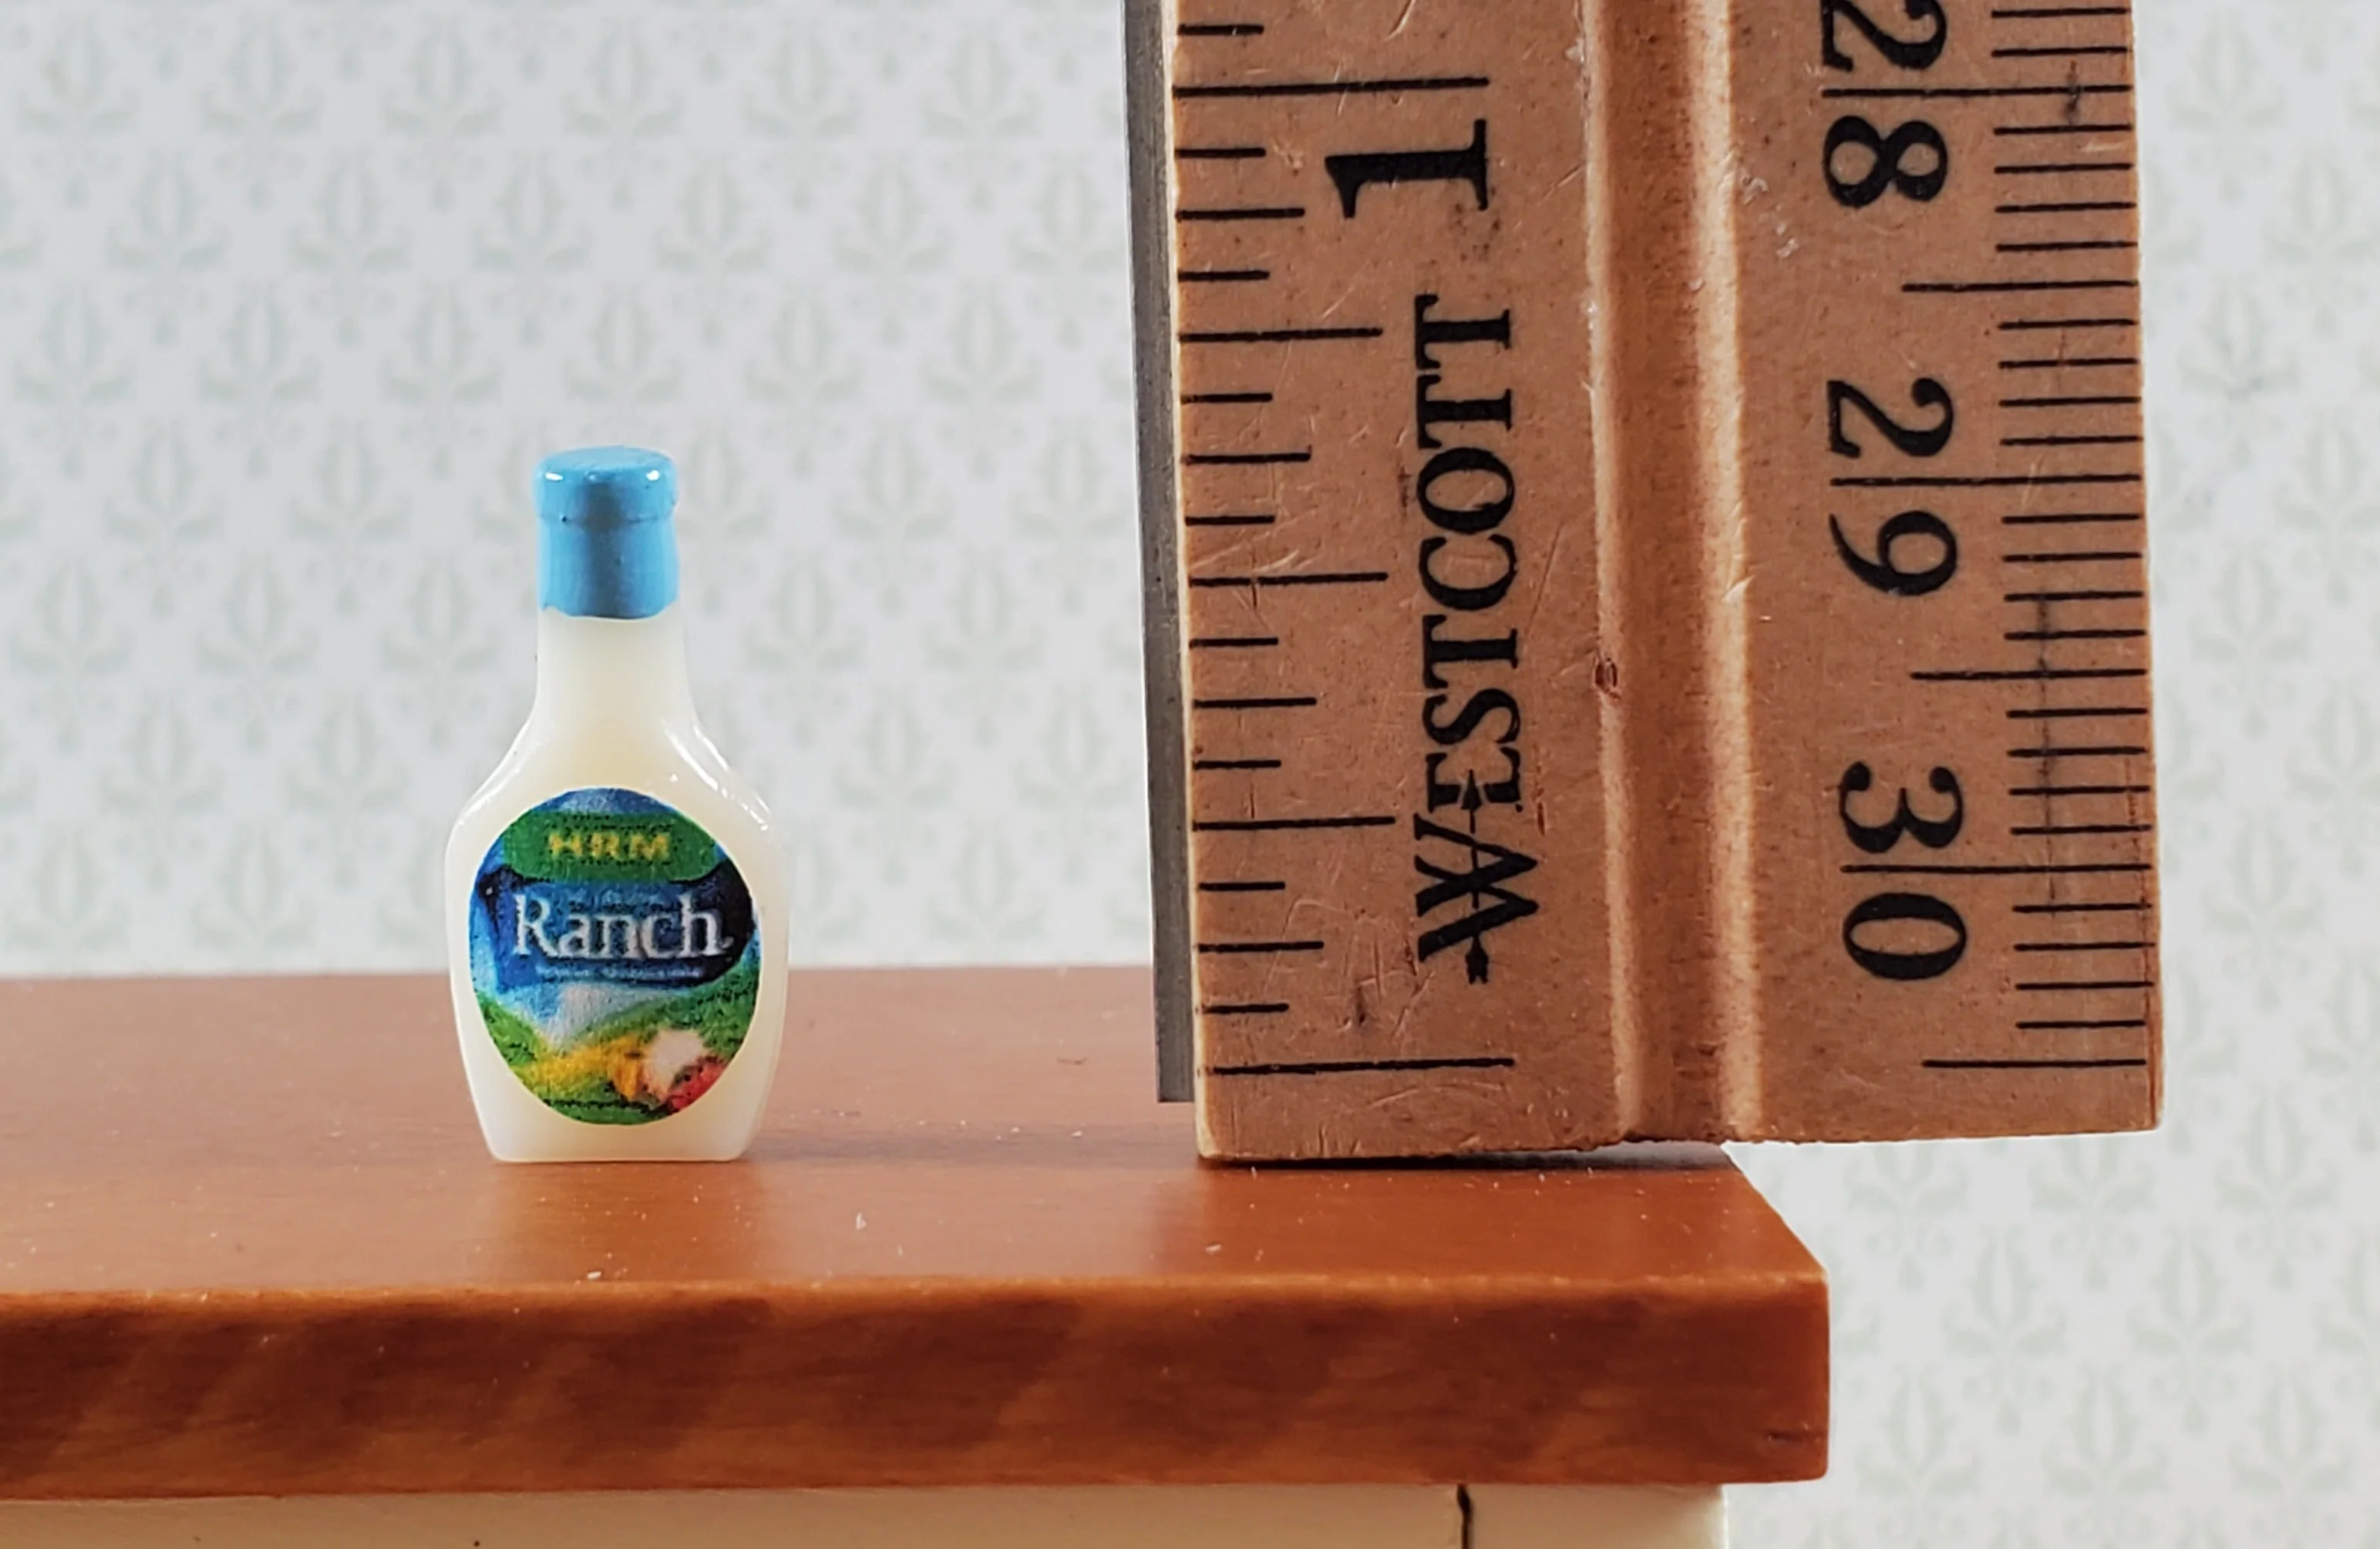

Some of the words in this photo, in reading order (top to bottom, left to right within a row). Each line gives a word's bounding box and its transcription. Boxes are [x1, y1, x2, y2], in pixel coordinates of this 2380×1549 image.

[1325, 119, 1488, 219] 1
[1820, 0, 1947, 208] 28
[1827, 377, 1957, 596] 29
[1413, 293, 1539, 962] WESTCOTT
[513, 894, 734, 959] Ranch
[548, 829, 672, 861] HRM
[1838, 761, 1967, 981] 30
